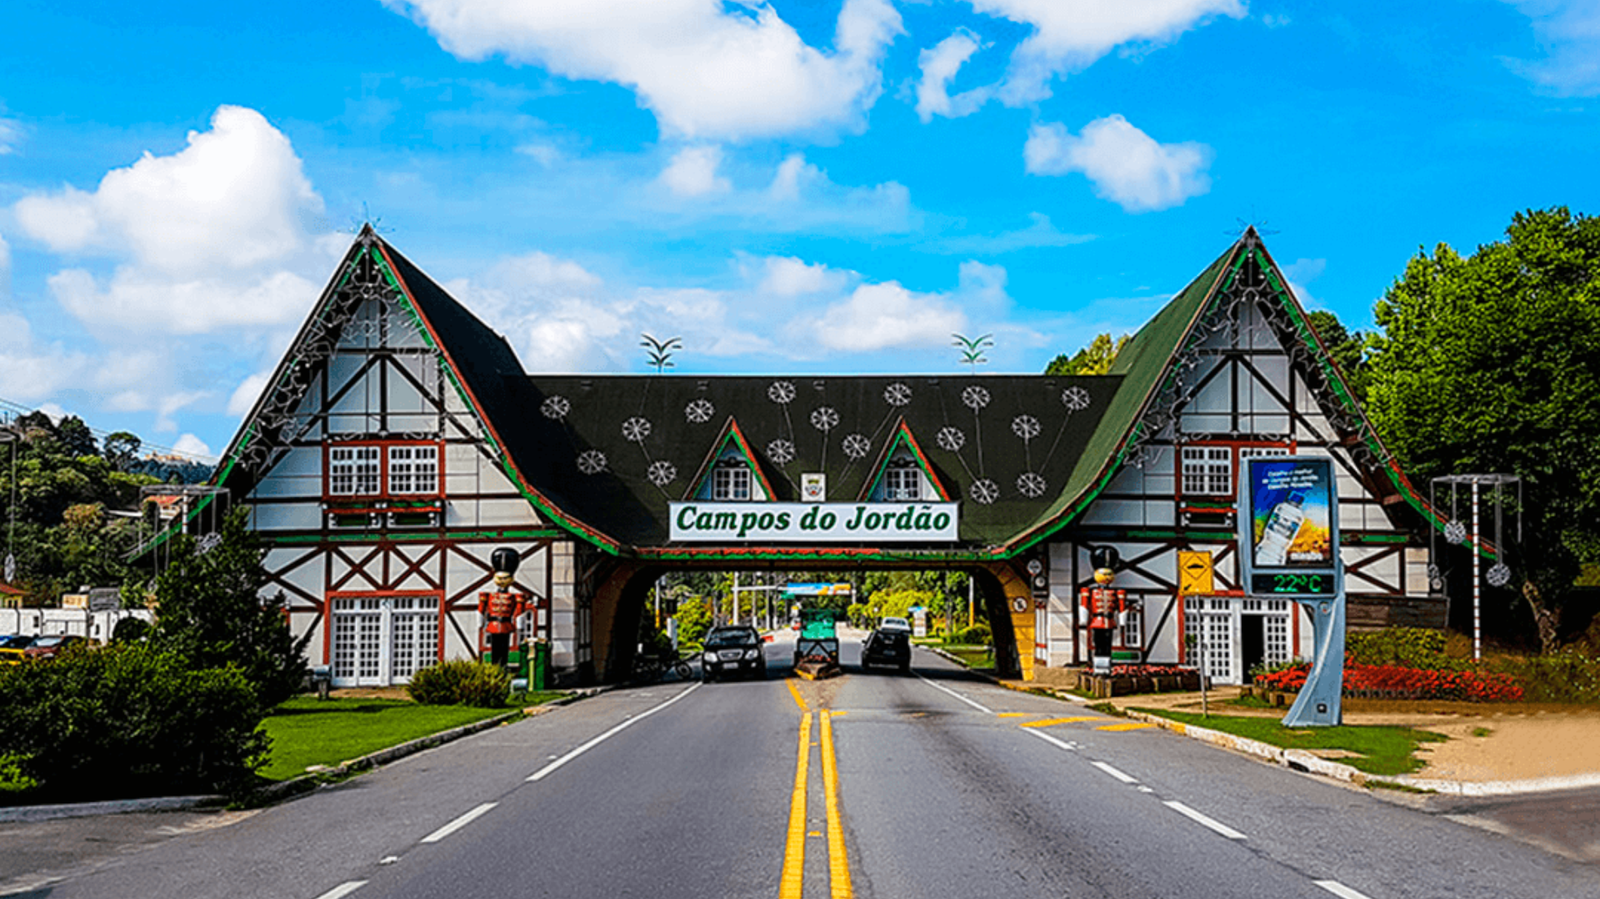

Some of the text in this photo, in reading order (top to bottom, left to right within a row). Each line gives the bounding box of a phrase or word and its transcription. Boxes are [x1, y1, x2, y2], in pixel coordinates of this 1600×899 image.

[676, 505, 951, 538] Campos do Jordão
